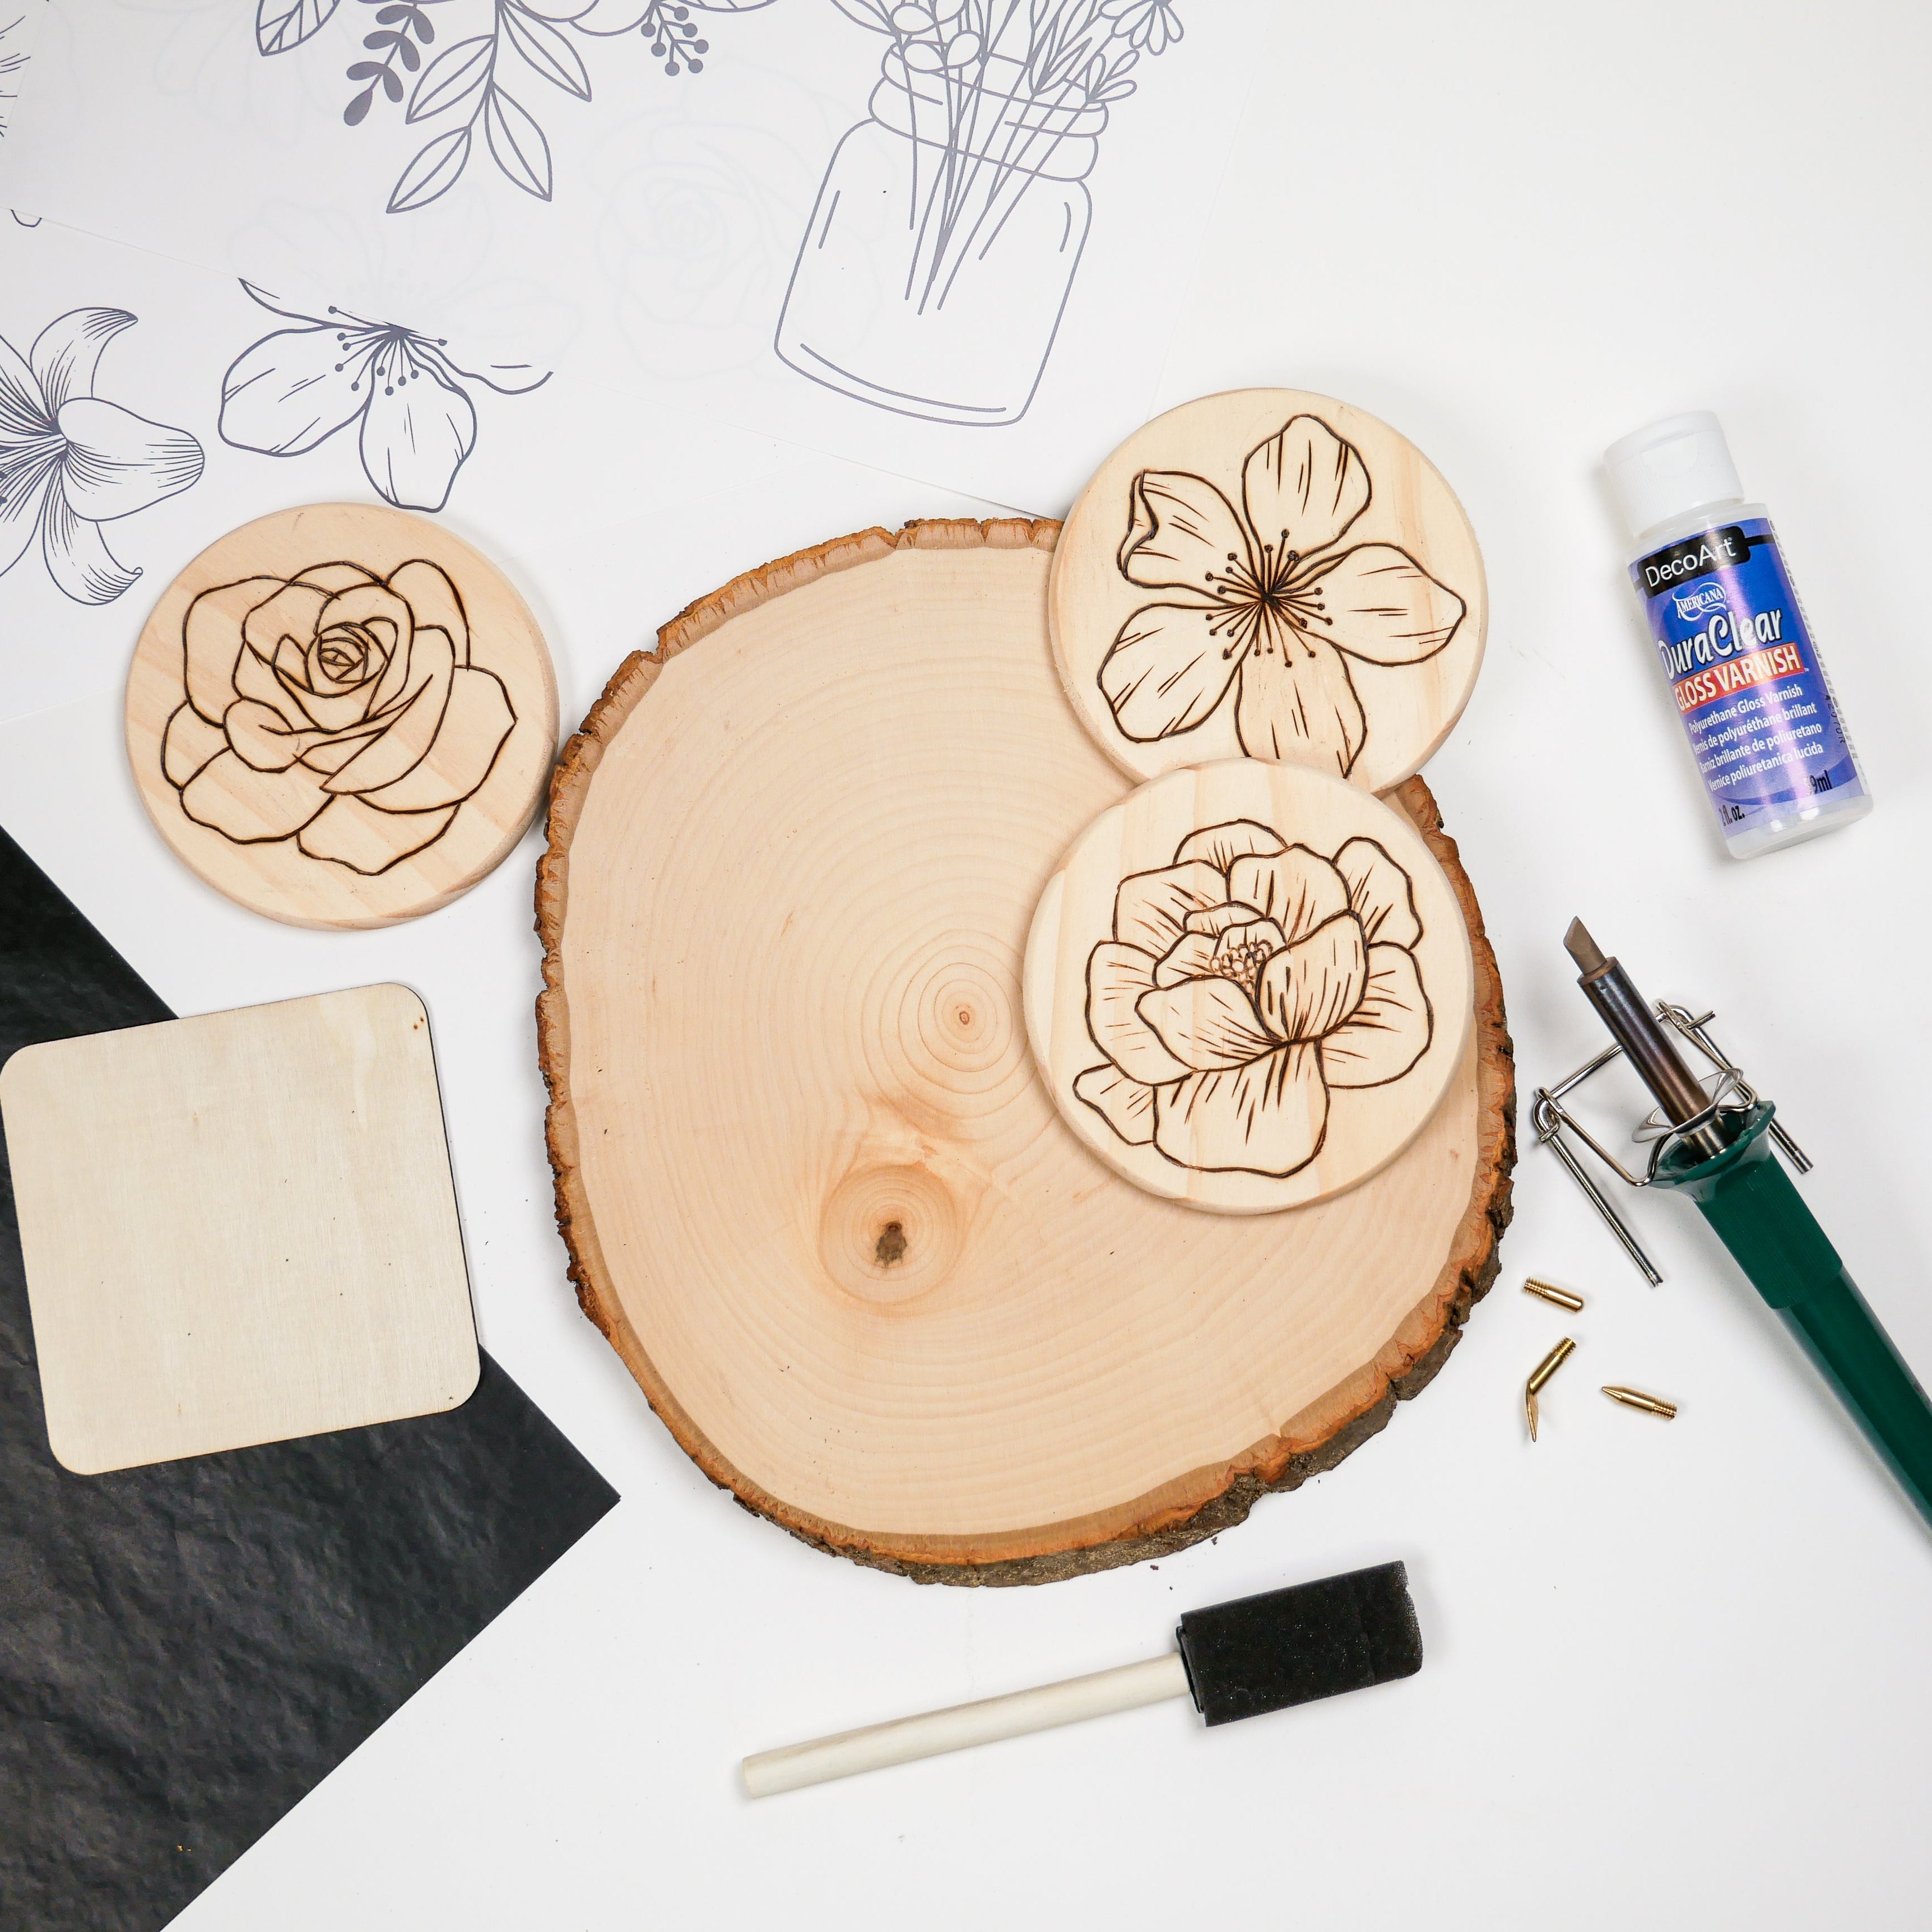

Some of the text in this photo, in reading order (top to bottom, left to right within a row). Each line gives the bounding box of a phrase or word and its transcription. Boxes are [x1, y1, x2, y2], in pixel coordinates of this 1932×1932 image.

[1677, 588, 1724, 619] AMERICANA
[1658, 609, 1781, 680] DuraClear
[1674, 672, 1717, 711] GLOSS
[1713, 645, 1801, 691] VARNISH
[1688, 684, 1803, 735] Polyurethane Gloss Varnish
[1708, 735, 1719, 748] de
[1717, 713, 1782, 747] polyuréthane
[1782, 702, 1817, 721] brillant
[1707, 741, 1824, 792] Vernice poliuretanica lucida
[1714, 745, 1751, 767] brillante
[1752, 738, 1766, 752] de
[1767, 723, 1822, 750] poliuretano
[1731, 805, 1745, 821] oz.
